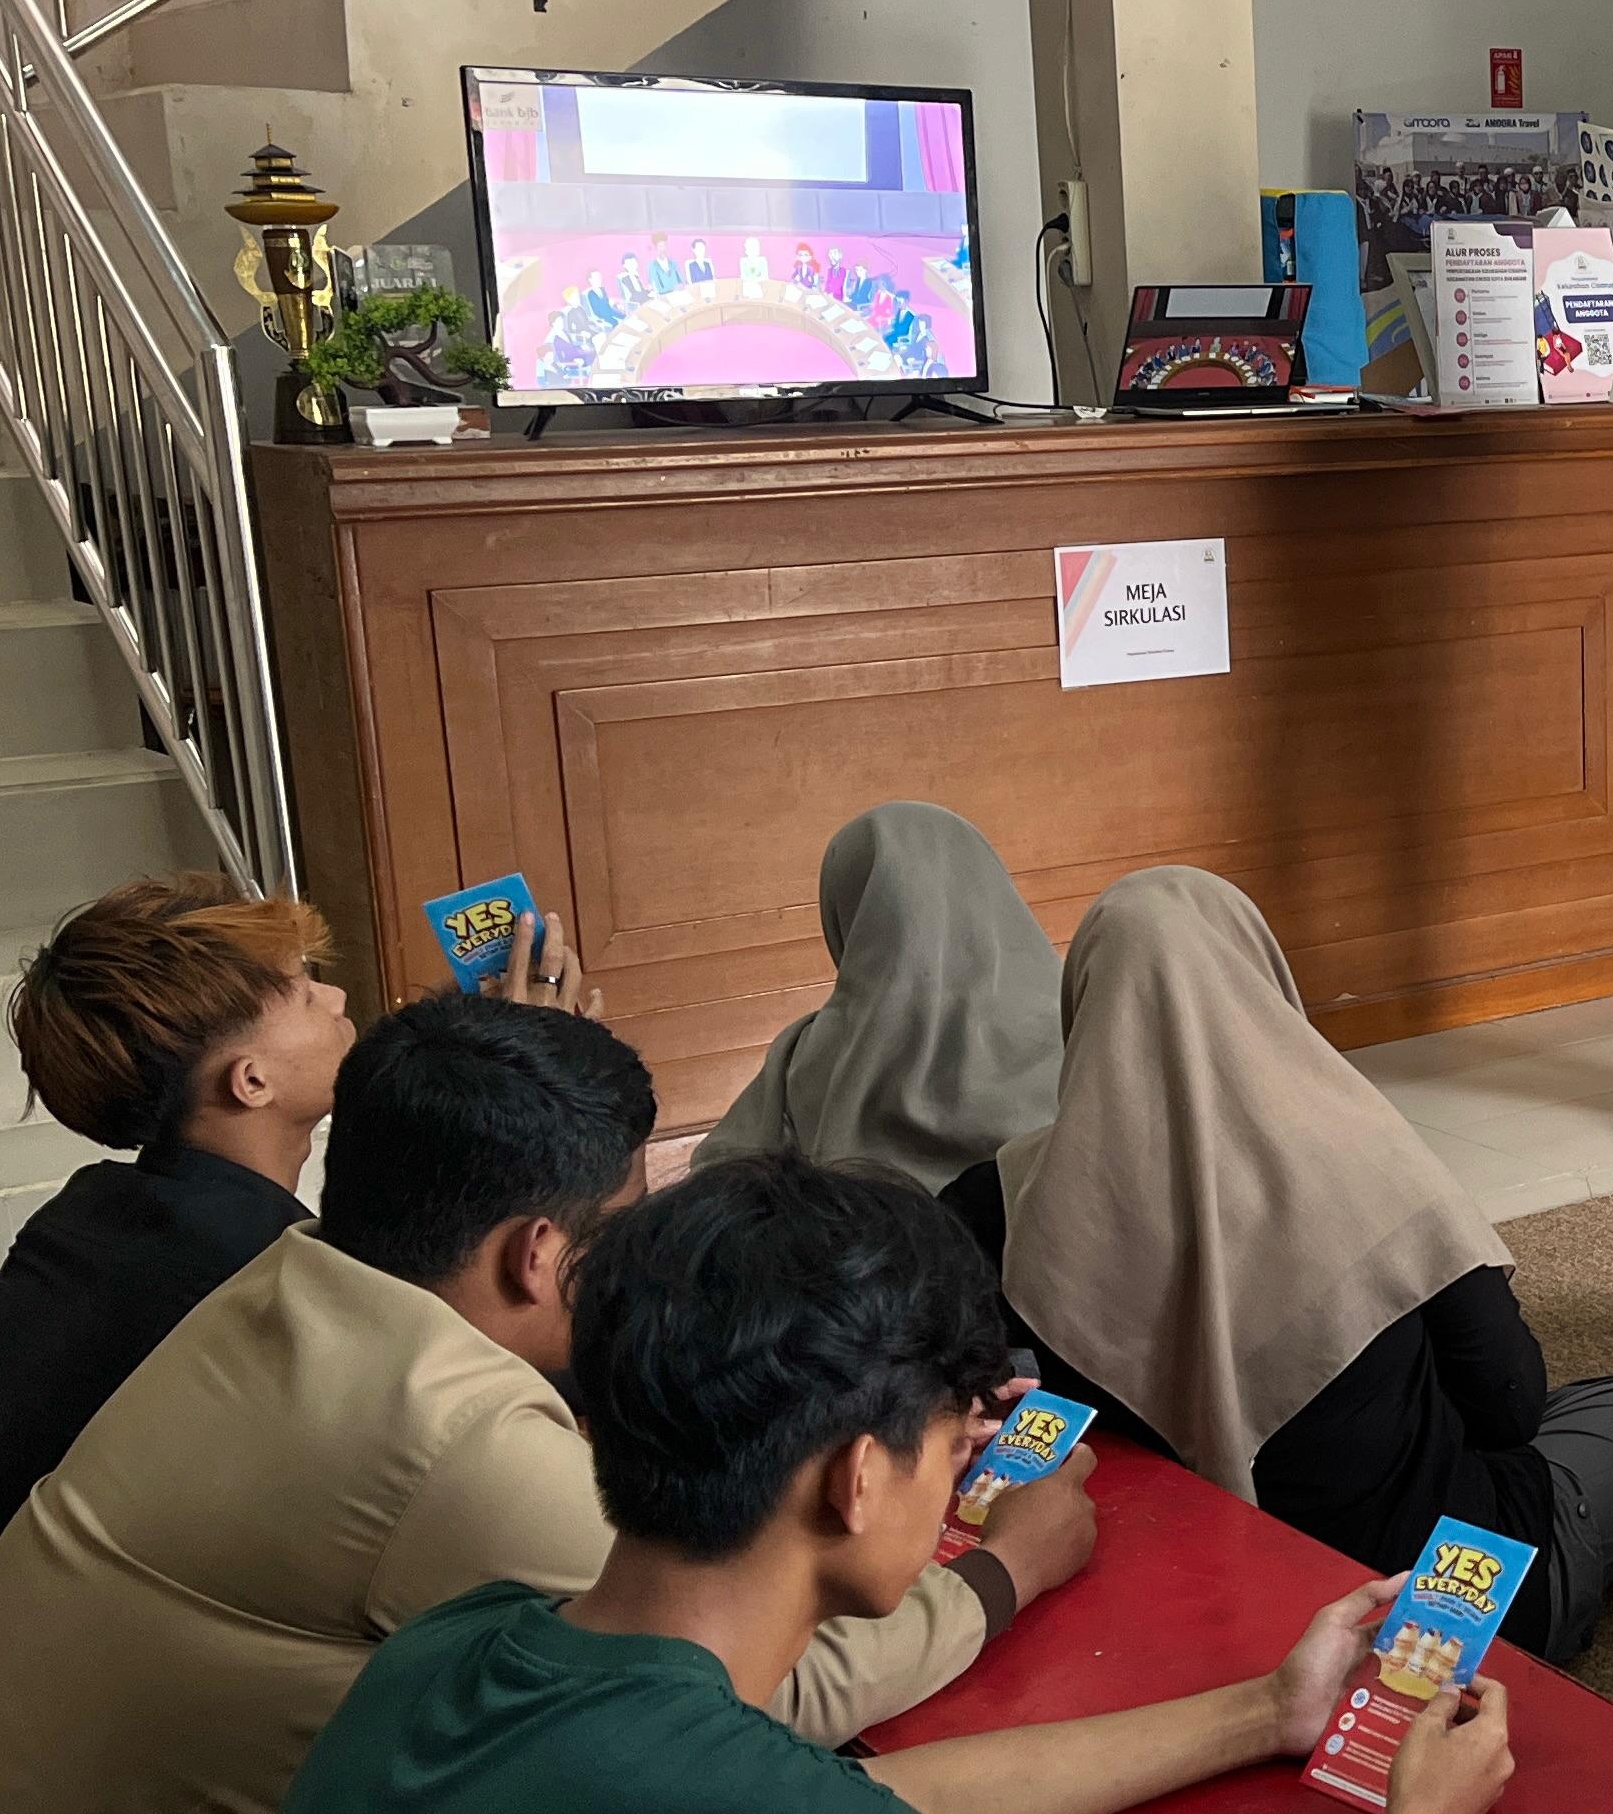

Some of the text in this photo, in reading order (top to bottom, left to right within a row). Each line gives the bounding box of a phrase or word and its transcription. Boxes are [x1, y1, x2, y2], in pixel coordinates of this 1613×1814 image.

[1519, 119, 1540, 128] Travel
[1446, 248, 1501, 257] ALUR PROSES
[1126, 583, 1167, 603] MEJA
[1104, 605, 1186, 627] SIRKULASI
[446, 899, 515, 938] YES
[452, 924, 515, 959] EVERYD
[1015, 1407, 1067, 1444] YES
[998, 1433, 1057, 1462] EVERYDAY
[1433, 1543, 1502, 1592] YES
[1414, 1574, 1498, 1615] EVERYDAY
